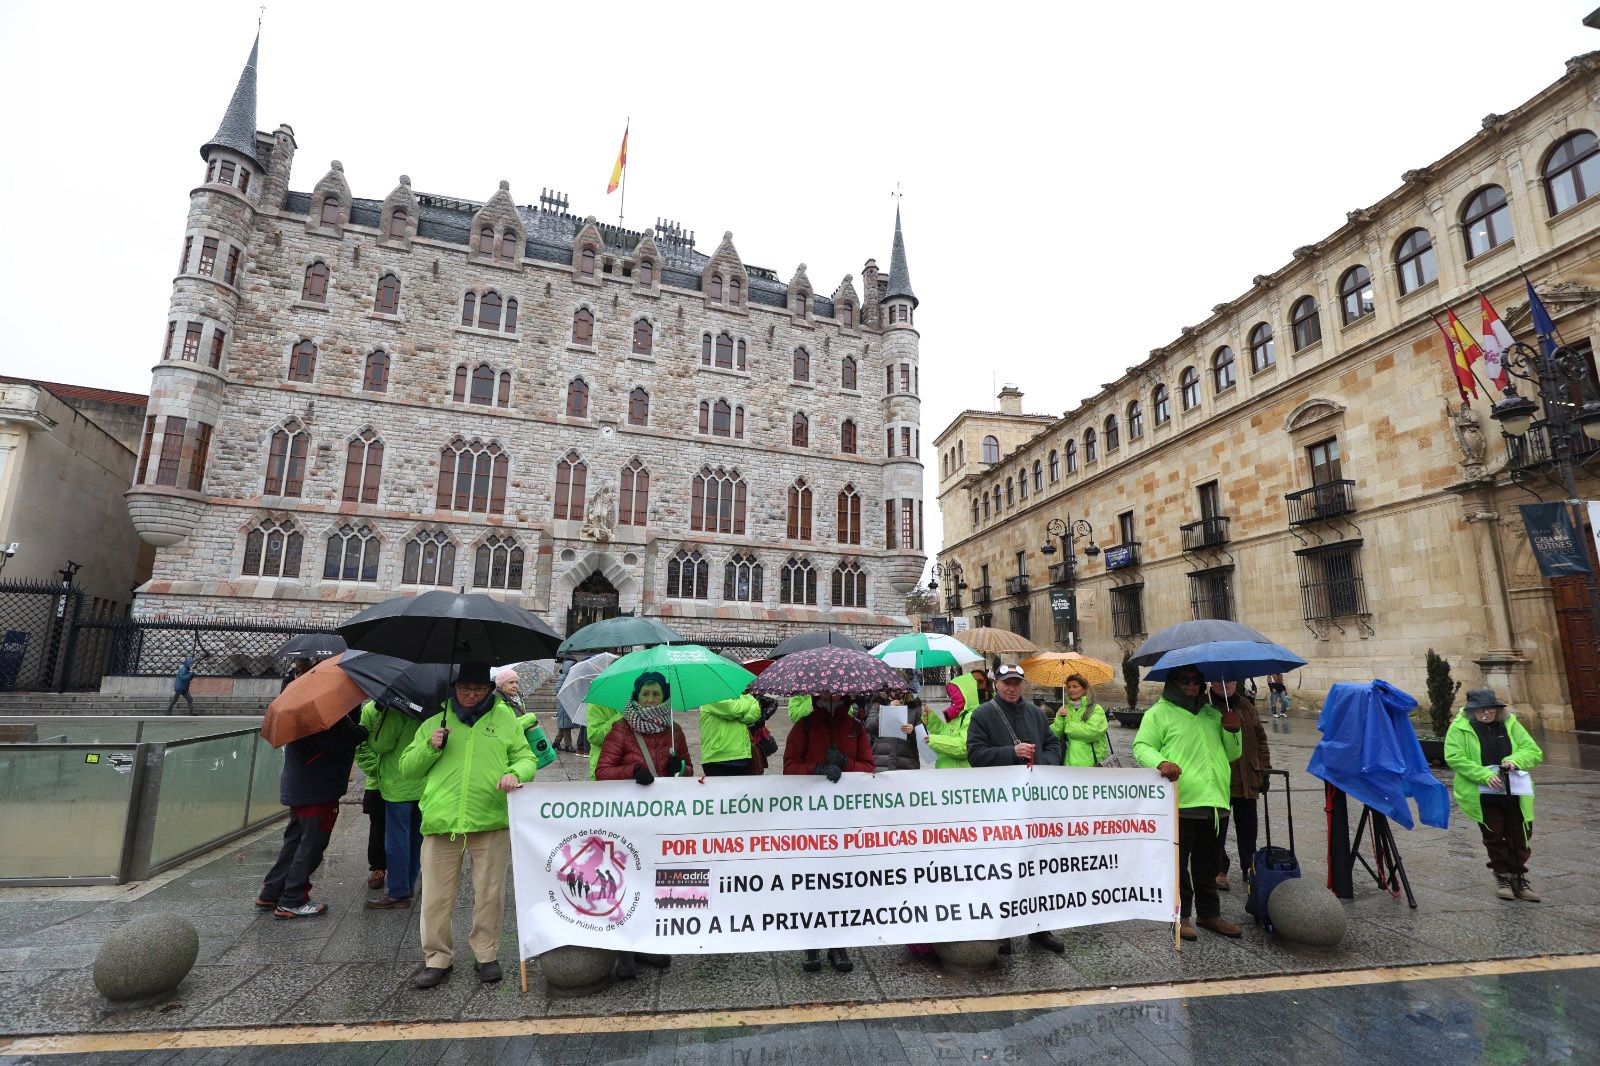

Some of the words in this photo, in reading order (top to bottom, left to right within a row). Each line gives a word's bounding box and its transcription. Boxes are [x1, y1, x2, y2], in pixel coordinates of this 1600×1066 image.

[540, 800, 687, 819] COORDINADORA
[693, 799, 714, 815] DE
[720, 794, 763, 815] LEÓN
[770, 796, 803, 812] POR
[809, 795, 828, 811] LA
[834, 793, 905, 810] DEFENSA
[910, 791, 937, 807] DEL
[942, 788, 1008, 805] SISTEMA
[1012, 782, 1068, 802] PÚBLICO
[1073, 786, 1089, 800] DE
[1093, 785, 1165, 799] PENSIONES
[662, 840, 696, 856] POR
[703, 837, 744, 854] UNAS
[750, 834, 838, 852] PENSIONES
[843, 829, 918, 850] PÚBLICAS
[923, 827, 977, 844] DIGNAS
[982, 825, 1023, 841] PARA
[1025, 822, 1063, 839] TODAS
[1067, 821, 1089, 836] LAS
[1093, 819, 1156, 835] PERSONAS
[545, 833, 578, 873] Coordinadora
[608, 832, 620, 840] por
[620, 836, 627, 845] la
[626, 843, 642, 871] Defensa
[657, 871, 710, 881] 11-Madrid
[720, 875, 763, 893] ¡¡NO
[771, 874, 784, 891] A
[792, 868, 907, 890] PENSIONES
[914, 861, 1012, 884] PÚBLICAS
[1019, 861, 1035, 878] DE
[1039, 854, 1118, 875] POBREZA!!
[548, 890, 557, 903] del
[552, 903, 575, 924] Sistema
[576, 920, 604, 932] Público
[656, 917, 701, 936] ¡¡NO
[708, 916, 722, 934] A
[730, 914, 753, 932] LA
[763, 902, 928, 931] PRIVATIZACIÓN
[935, 904, 962, 922] DE
[968, 903, 993, 920] LA
[999, 891, 1087, 919] SEGURIDAD
[1092, 887, 1162, 905] SOCIAL!!
[605, 923, 616, 931] de
